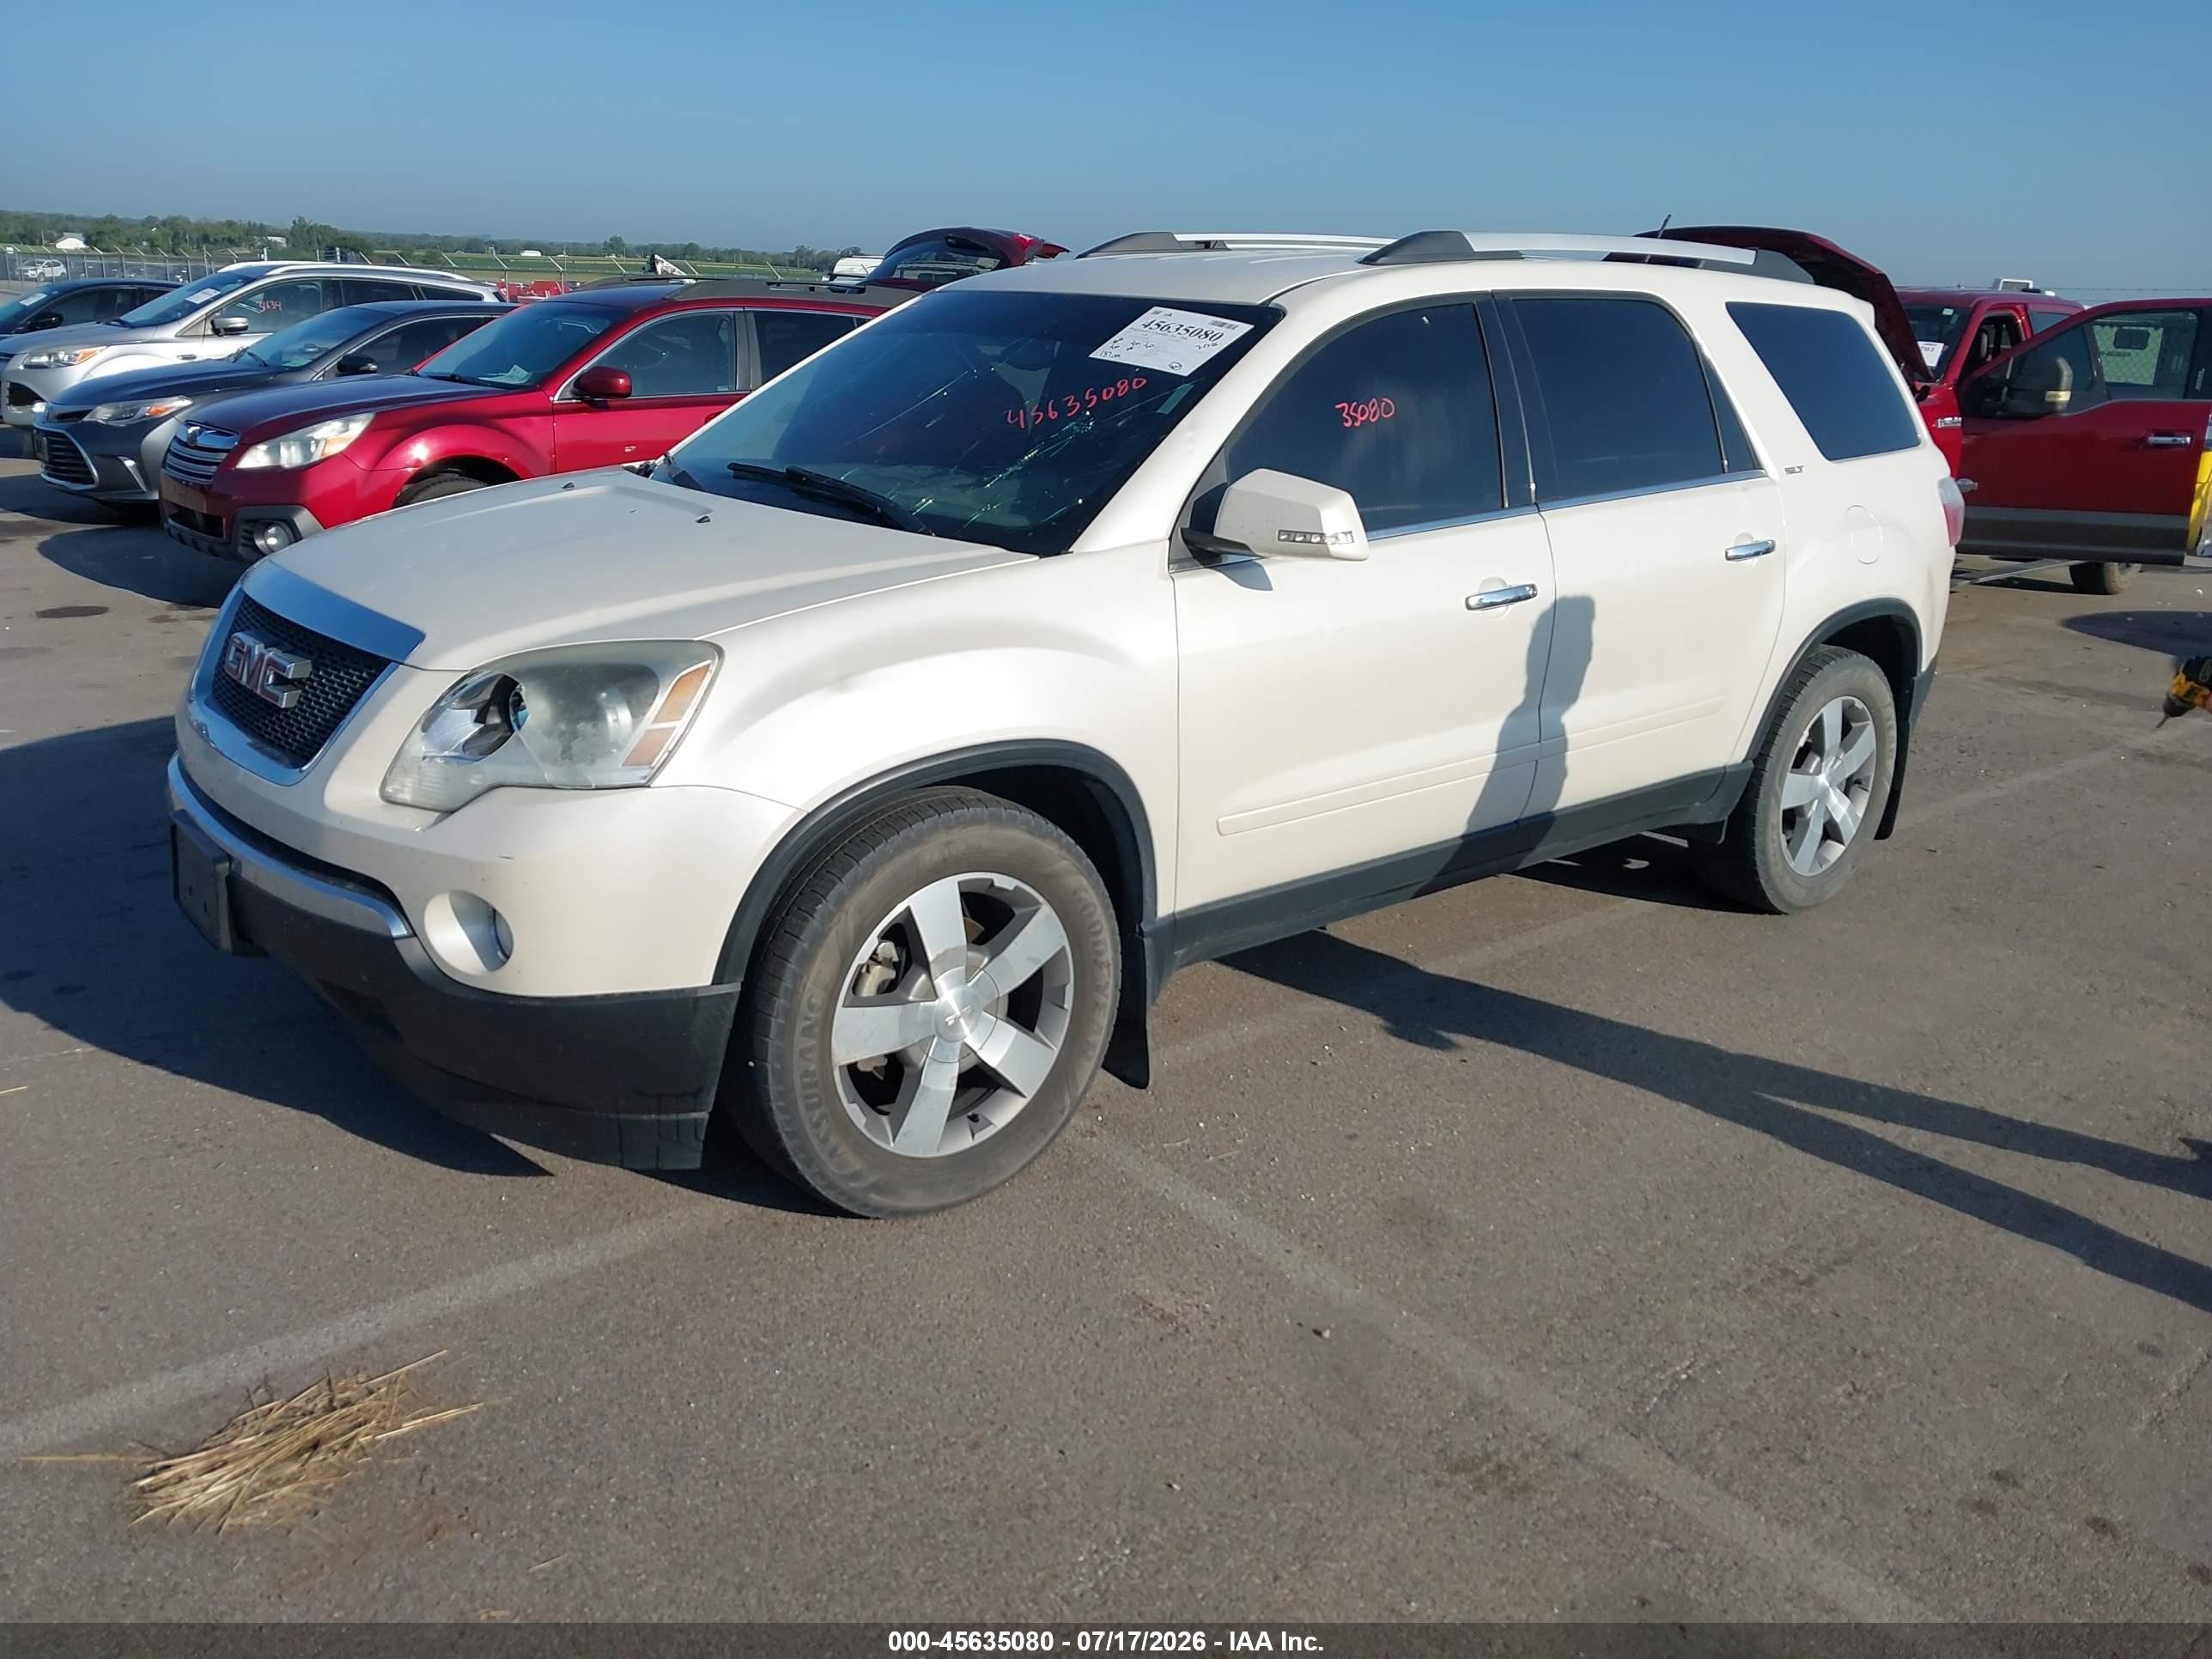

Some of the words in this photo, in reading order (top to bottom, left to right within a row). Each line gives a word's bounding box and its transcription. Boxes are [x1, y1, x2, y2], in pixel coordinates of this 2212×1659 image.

[1140, 319, 1224, 342] 45635080
[1006, 377, 1148, 428] 45635080
[1334, 398, 1395, 428] 35080
[224, 632, 312, 708] GMC
